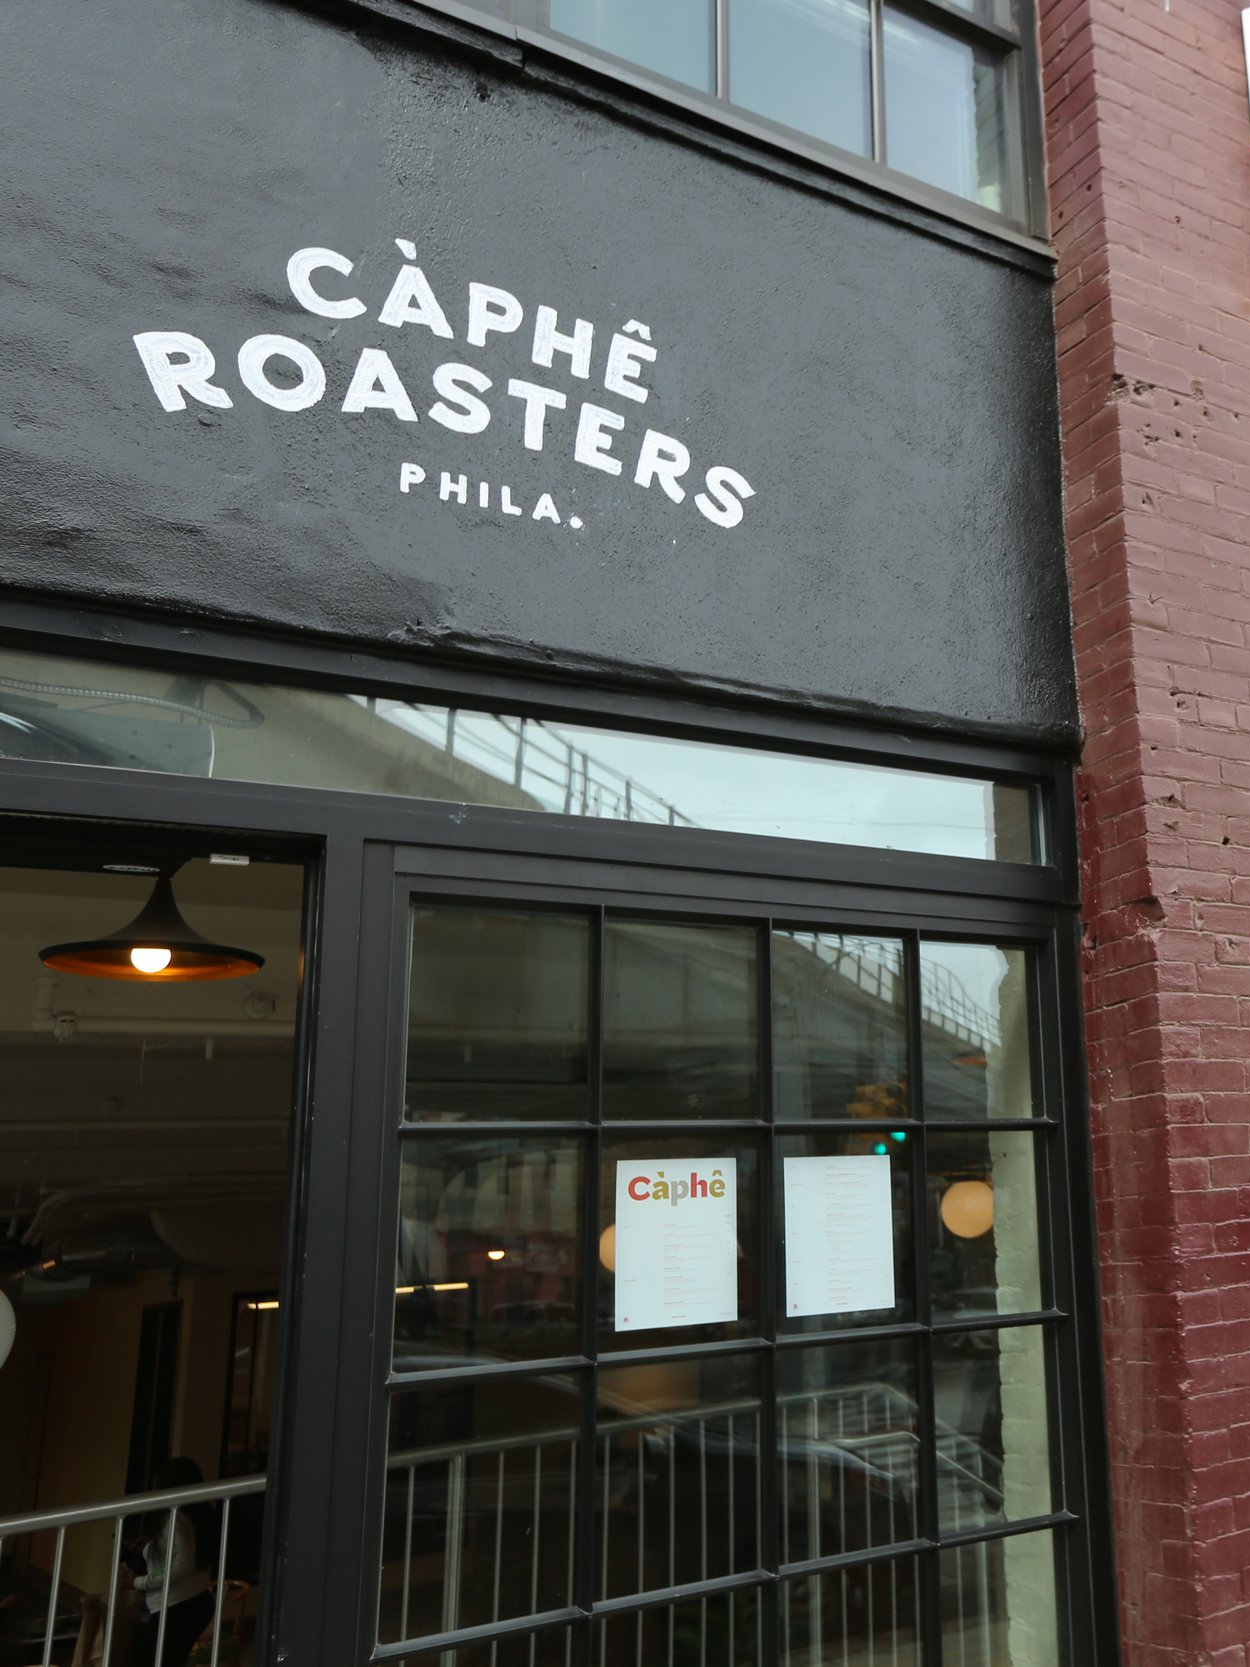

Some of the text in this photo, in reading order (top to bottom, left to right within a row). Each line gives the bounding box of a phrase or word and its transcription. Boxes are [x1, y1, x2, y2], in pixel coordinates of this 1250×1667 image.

[286, 238, 658, 404] CÀPHÊ
[132, 331, 757, 529] ROASTERS
[399, 462, 584, 529] PHILA.
[627, 1169, 726, 1207] Càphê
